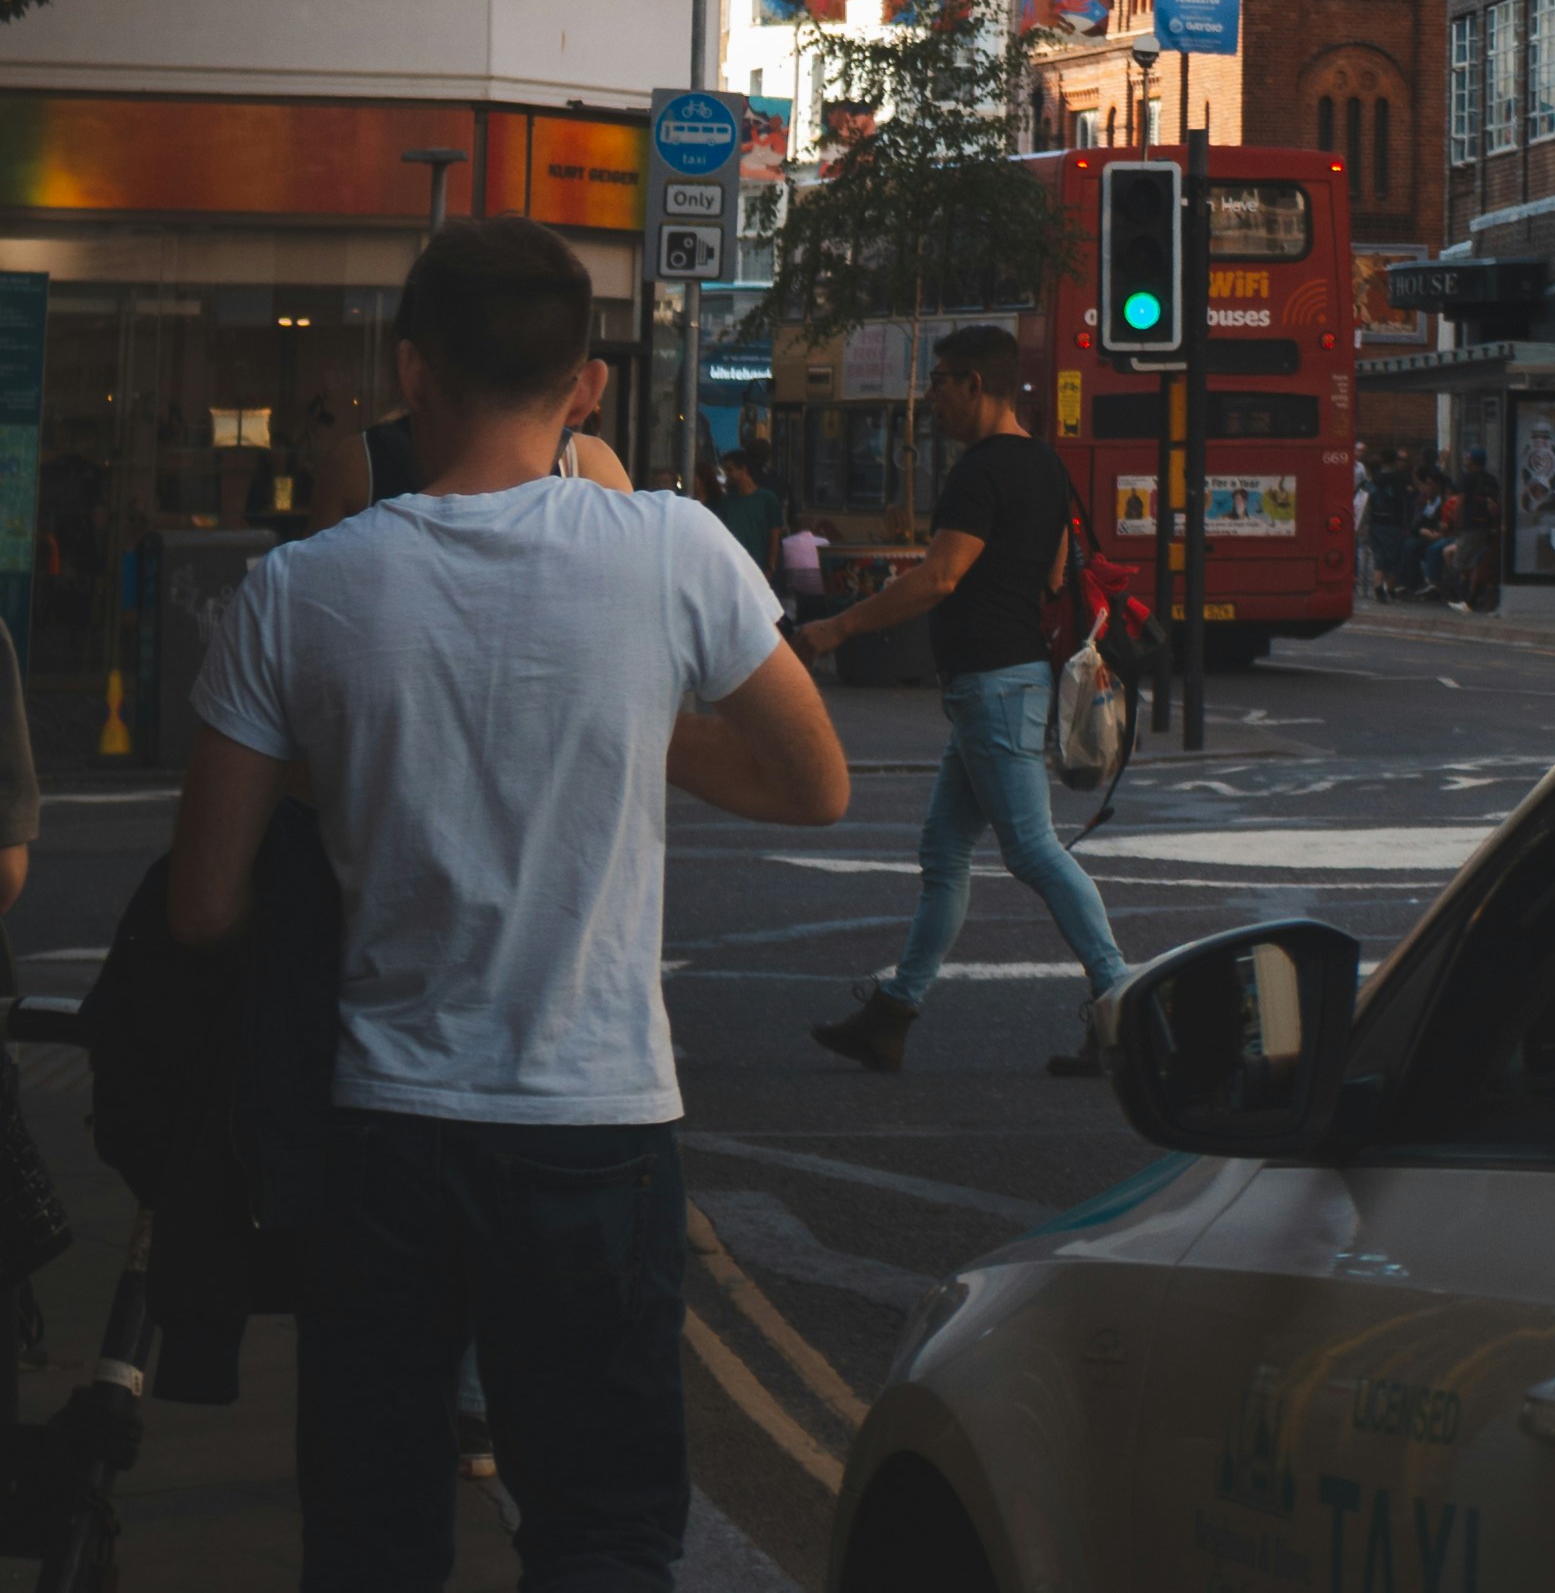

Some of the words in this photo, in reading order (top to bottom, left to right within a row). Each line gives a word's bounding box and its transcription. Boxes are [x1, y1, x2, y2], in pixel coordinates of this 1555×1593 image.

[682, 154, 706, 165] taxi
[548, 164, 585, 181] KURT
[588, 167, 640, 186] GEIGER
[674, 191, 714, 209] Only
[1208, 270, 1269, 299] WiFi
[1395, 273, 1459, 298] HOUSE
[1206, 306, 1271, 327] buses
[1354, 1377, 1460, 1444] LICENSED
[1319, 1475, 1480, 1593] TAXI
